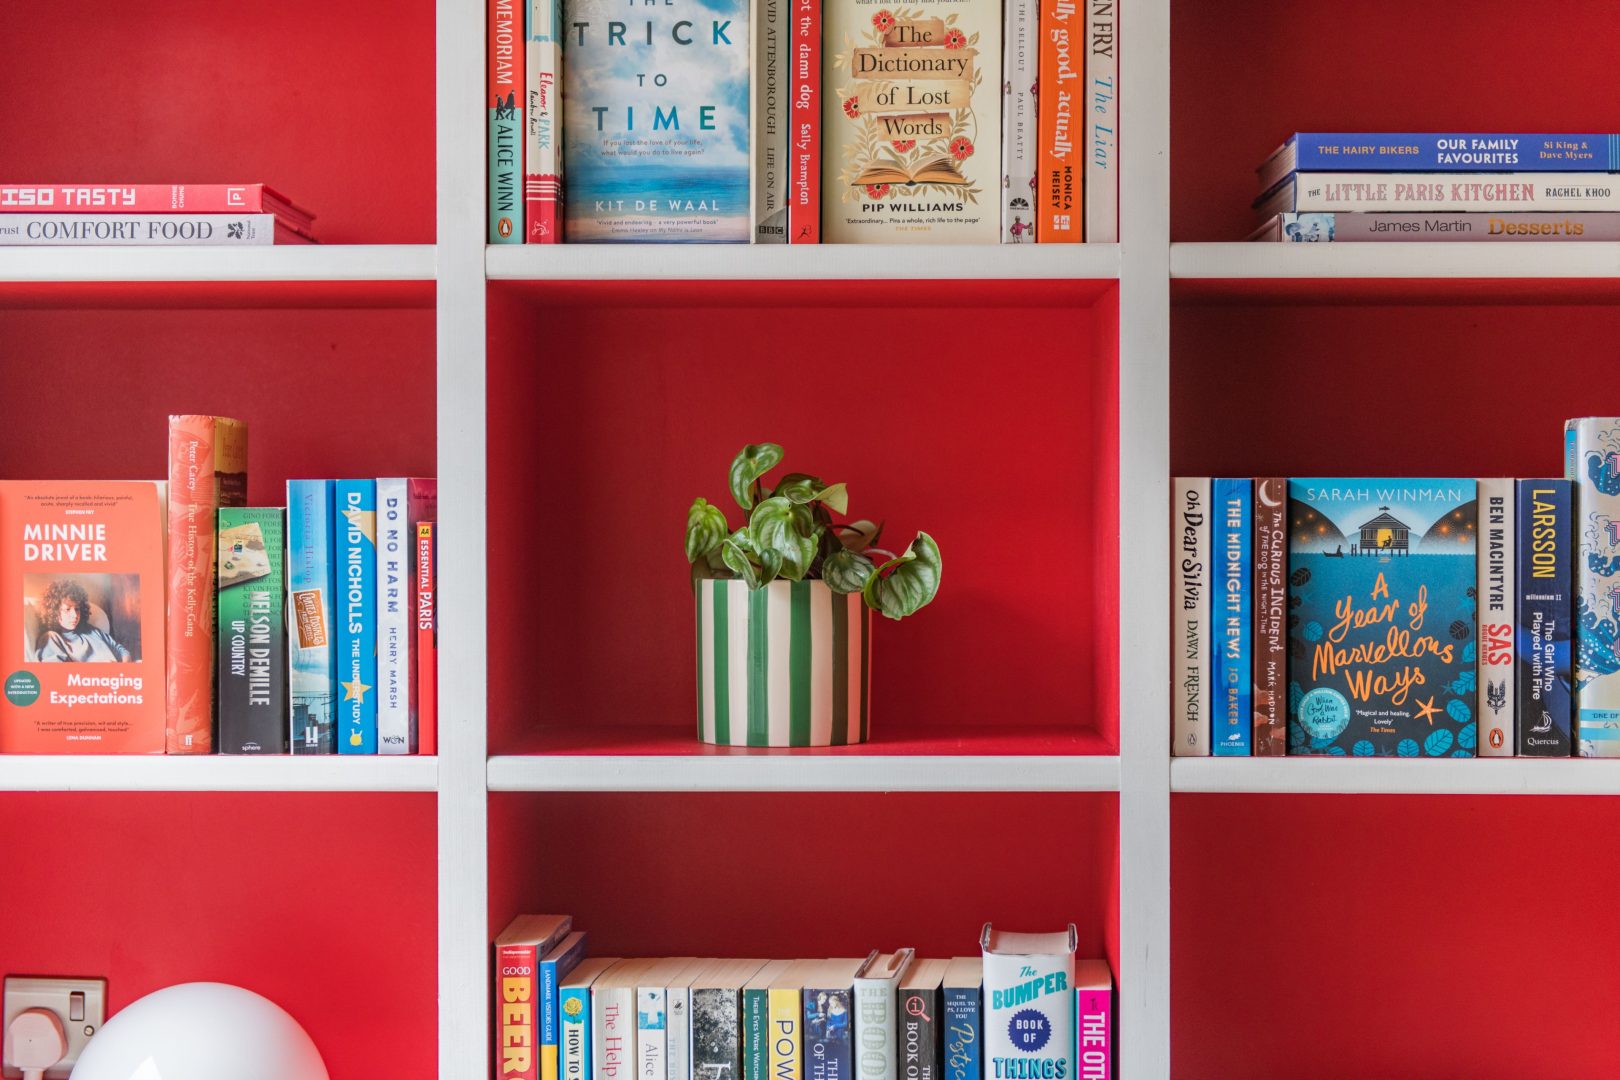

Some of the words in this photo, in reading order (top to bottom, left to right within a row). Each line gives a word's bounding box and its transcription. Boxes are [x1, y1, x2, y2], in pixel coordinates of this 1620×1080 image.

[573, 20, 732, 47] TRICK
[800, 16, 812, 37] the
[893, 25, 932, 43] The
[1017, 27, 1025, 72] SELLOUT
[1093, 22, 1113, 59] FRY
[799, 44, 812, 79] damn
[858, 53, 969, 77] Dictionary
[1050, 28, 1078, 85] good,
[636, 74, 668, 87] TO
[766, 27, 777, 135] ATTENBOROUGH
[796, 84, 814, 110] dog
[876, 87, 900, 105] of
[907, 86, 951, 105] Lost
[1016, 92, 1024, 117] PAUL
[1094, 76, 1113, 114] The
[592, 105, 716, 131] TIME
[884, 118, 943, 135] Words
[1049, 90, 1073, 163] actually
[497, 124, 514, 167] ALICE
[538, 119, 551, 150] PARK
[796, 123, 812, 150] Sally
[1016, 122, 1024, 160] BEATTY
[1094, 124, 1113, 169] Liar
[1437, 139, 1467, 150] OUR
[1471, 139, 1519, 150] FAMILY
[1543, 141, 1553, 150] Si
[1556, 141, 1578, 151] King
[1581, 141, 1588, 149] &
[684, 149, 705, 157] again?
[766, 147, 775, 169] LIFE
[1318, 146, 1340, 154] THE
[1342, 146, 1376, 154] HAIRY
[1379, 146, 1420, 155] BIKERS
[1437, 153, 1519, 164] FAVOURITES
[1540, 151, 1564, 159] Dave
[1565, 151, 1593, 161] Myers
[497, 172, 514, 211] WINN
[766, 171, 775, 189] ON
[796, 154, 811, 205] Brampton
[1051, 170, 1061, 208] HEISEY
[1063, 166, 1073, 210] MONICA
[1308, 188, 1321, 198] THE
[1325, 183, 1388, 202] LITTLE
[1395, 183, 1445, 202] PARIS
[1451, 183, 1535, 202] KITCHEN
[1545, 187, 1581, 197] RACHEL
[1585, 188, 1611, 198] KHOO
[61, 188, 136, 205] TASTY
[595, 200, 624, 212] KIT
[635, 200, 657, 211] DE
[668, 199, 720, 211] WAAL
[766, 192, 775, 211] AIR
[862, 203, 885, 212] PIP
[889, 202, 964, 212] WILLIAMS
[26, 221, 141, 239] COMFORT
[147, 221, 213, 239] FOOD
[1369, 219, 1421, 233] James
[1425, 219, 1472, 232] Martin
[1487, 217, 1585, 236] Desserts
[189, 440, 199, 464] Peter
[187, 465, 199, 491] Carey
[1306, 488, 1370, 501] SARAH
[1376, 488, 1462, 501] WINMAN
[188, 503, 198, 523] True
[303, 494, 313, 540] Victoria
[347, 492, 362, 544] DAVID
[386, 498, 398, 520] DO
[1227, 499, 1241, 528] THE
[1489, 496, 1504, 524] BEN
[23, 523, 107, 541] MINNIE
[186, 525, 197, 556] History
[387, 530, 398, 552] NO
[1183, 512, 1204, 558] Dear
[1532, 489, 1556, 578] LARSSON
[24, 543, 108, 561] DRIVER
[187, 557, 197, 568] of
[303, 545, 314, 584] Hislop
[420, 540, 429, 588] ESSENTIAL
[187, 570, 197, 586] the
[1226, 533, 1241, 613] MIDNIGHT
[1489, 528, 1504, 611] MACINTYRE
[347, 547, 363, 634] NICHOLLS
[387, 561, 399, 613] HARM
[1182, 558, 1203, 611] Silvia
[1370, 572, 1389, 600] A
[184, 588, 197, 613] Kelly
[419, 592, 433, 630] PARIS
[1328, 595, 1400, 643] Year
[1408, 583, 1429, 631] of
[184, 614, 196, 637] Gang
[231, 620, 245, 633] UP
[249, 591, 271, 644] NELSON
[1544, 620, 1555, 641] The
[1186, 620, 1199, 660] DAWN
[1226, 617, 1241, 659] NEWS
[1487, 623, 1512, 666] SAS
[1532, 612, 1543, 651] Played
[231, 634, 246, 677] COUNTRY
[351, 638, 360, 657] THE
[389, 627, 397, 664] HENRY
[1312, 625, 1454, 682] Marvellous
[1544, 643, 1555, 664] Girl
[249, 649, 271, 706] DEMILLE
[1267, 661, 1277, 687] MARK
[1532, 652, 1543, 676] with
[67, 673, 143, 690] Managing
[351, 659, 361, 725] UNDERSTUDY
[389, 670, 398, 709] MARSH
[1344, 666, 1426, 705] Ways
[1532, 678, 1543, 700] Fire
[1544, 665, 1555, 692] Who
[50, 691, 143, 708] Expectations
[1184, 666, 1199, 722] FRENCH
[1267, 690, 1276, 725] HADDON
[241, 744, 261, 752] sphere
[1527, 737, 1559, 746] Quercus
[502, 966, 531, 976] GOOD
[1019, 965, 1038, 978] The
[992, 971, 1068, 1010] BUMPER
[502, 977, 532, 1075] BEER
[605, 1002, 620, 1031] The
[1016, 1019, 1044, 1030] BOOK
[1083, 1011, 1106, 1047] THE
[568, 1029, 580, 1057] HOW
[906, 1021, 919, 1064] BOOK
[1023, 1033, 1037, 1043] OF
[568, 1060, 580, 1074] TO
[602, 1037, 622, 1077] Help
[645, 1043, 659, 1076] Alice
[992, 1057, 1067, 1080] THINGS
